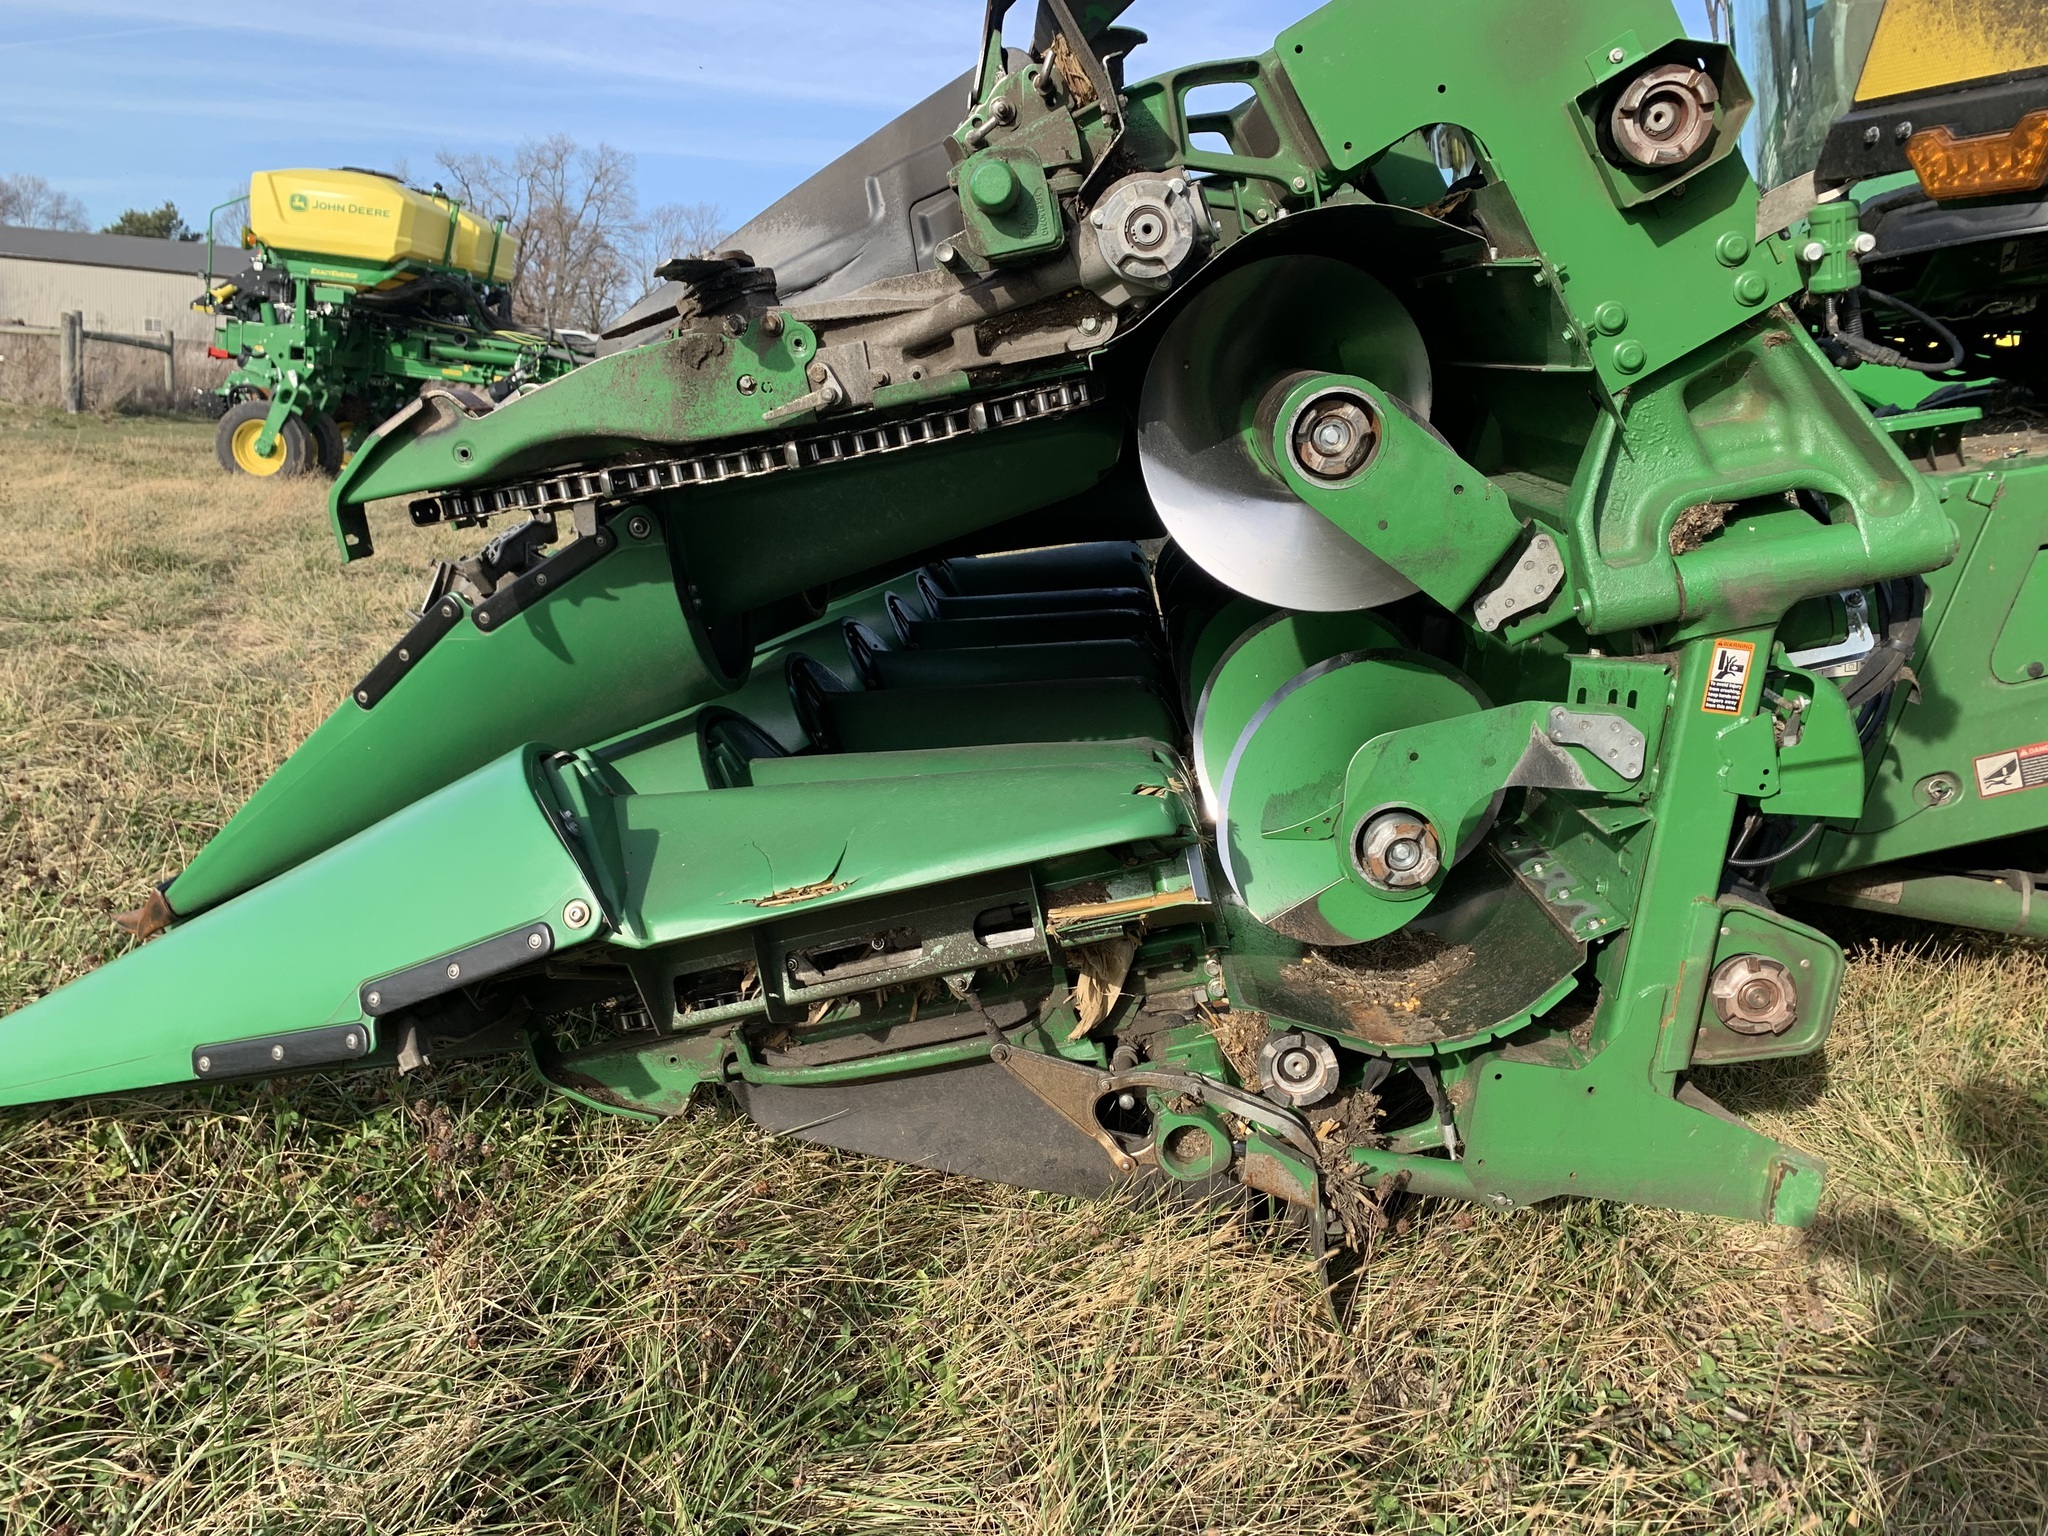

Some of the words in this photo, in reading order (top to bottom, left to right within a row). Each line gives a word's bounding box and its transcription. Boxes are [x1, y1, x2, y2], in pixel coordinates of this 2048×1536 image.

[312, 200, 345, 212] JOHN
[348, 203, 391, 218] DEERE
[1723, 641, 1753, 650] WARNING
